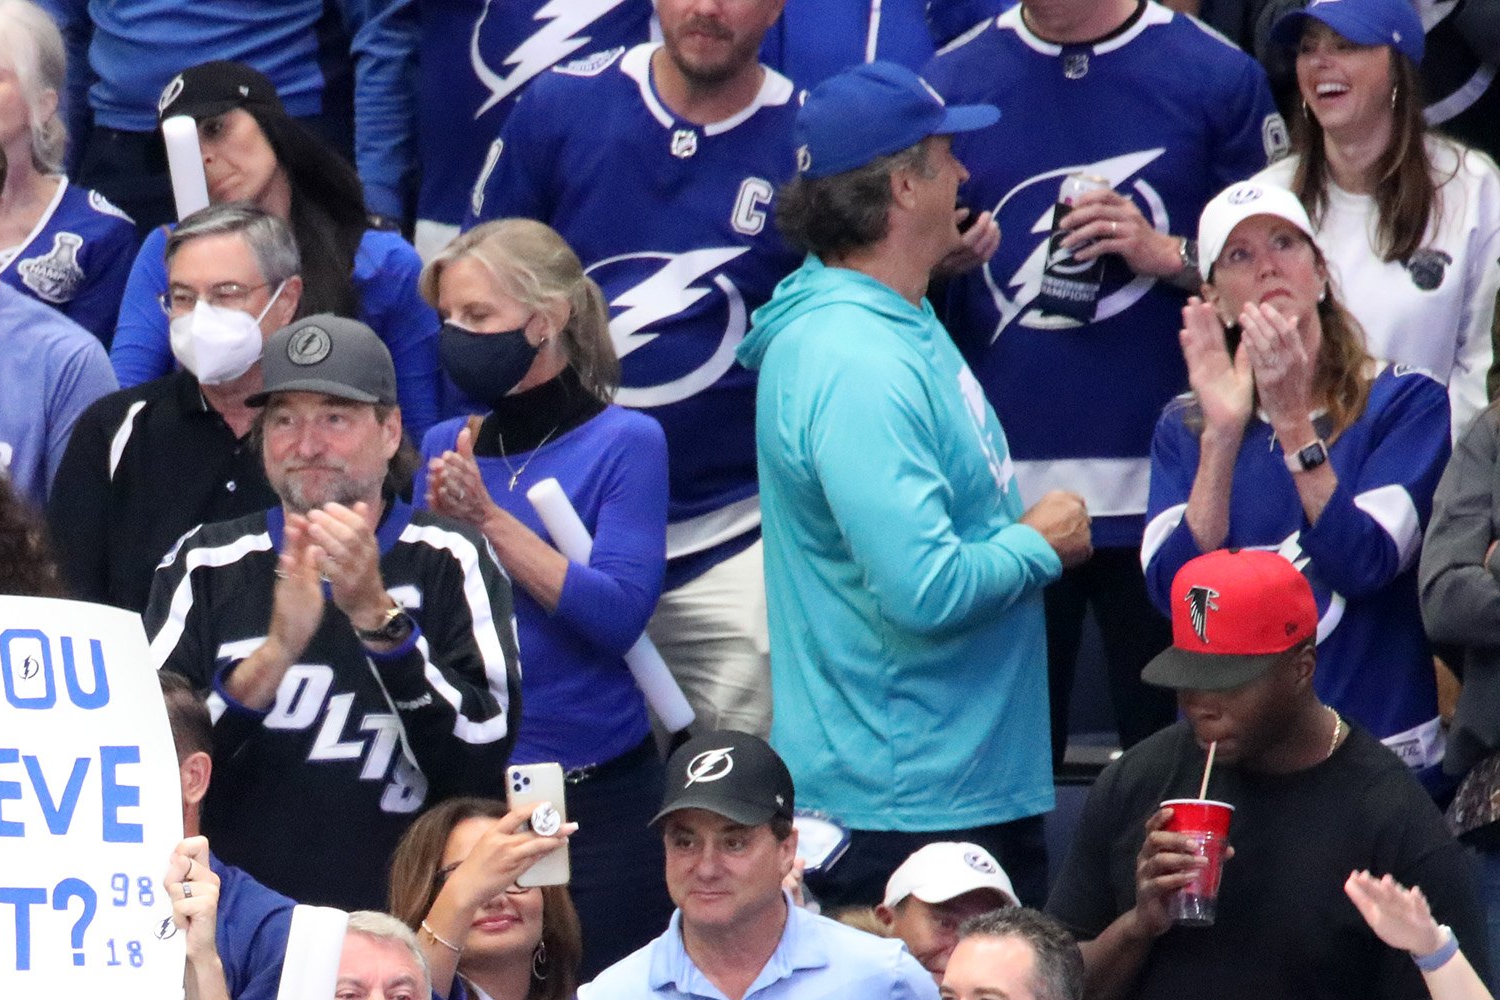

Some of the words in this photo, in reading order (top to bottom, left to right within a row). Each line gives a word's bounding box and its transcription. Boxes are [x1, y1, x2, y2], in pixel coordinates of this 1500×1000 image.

[730, 176, 774, 236] C
[110, 873, 155, 907] 98
[105, 937, 145, 969] 18
